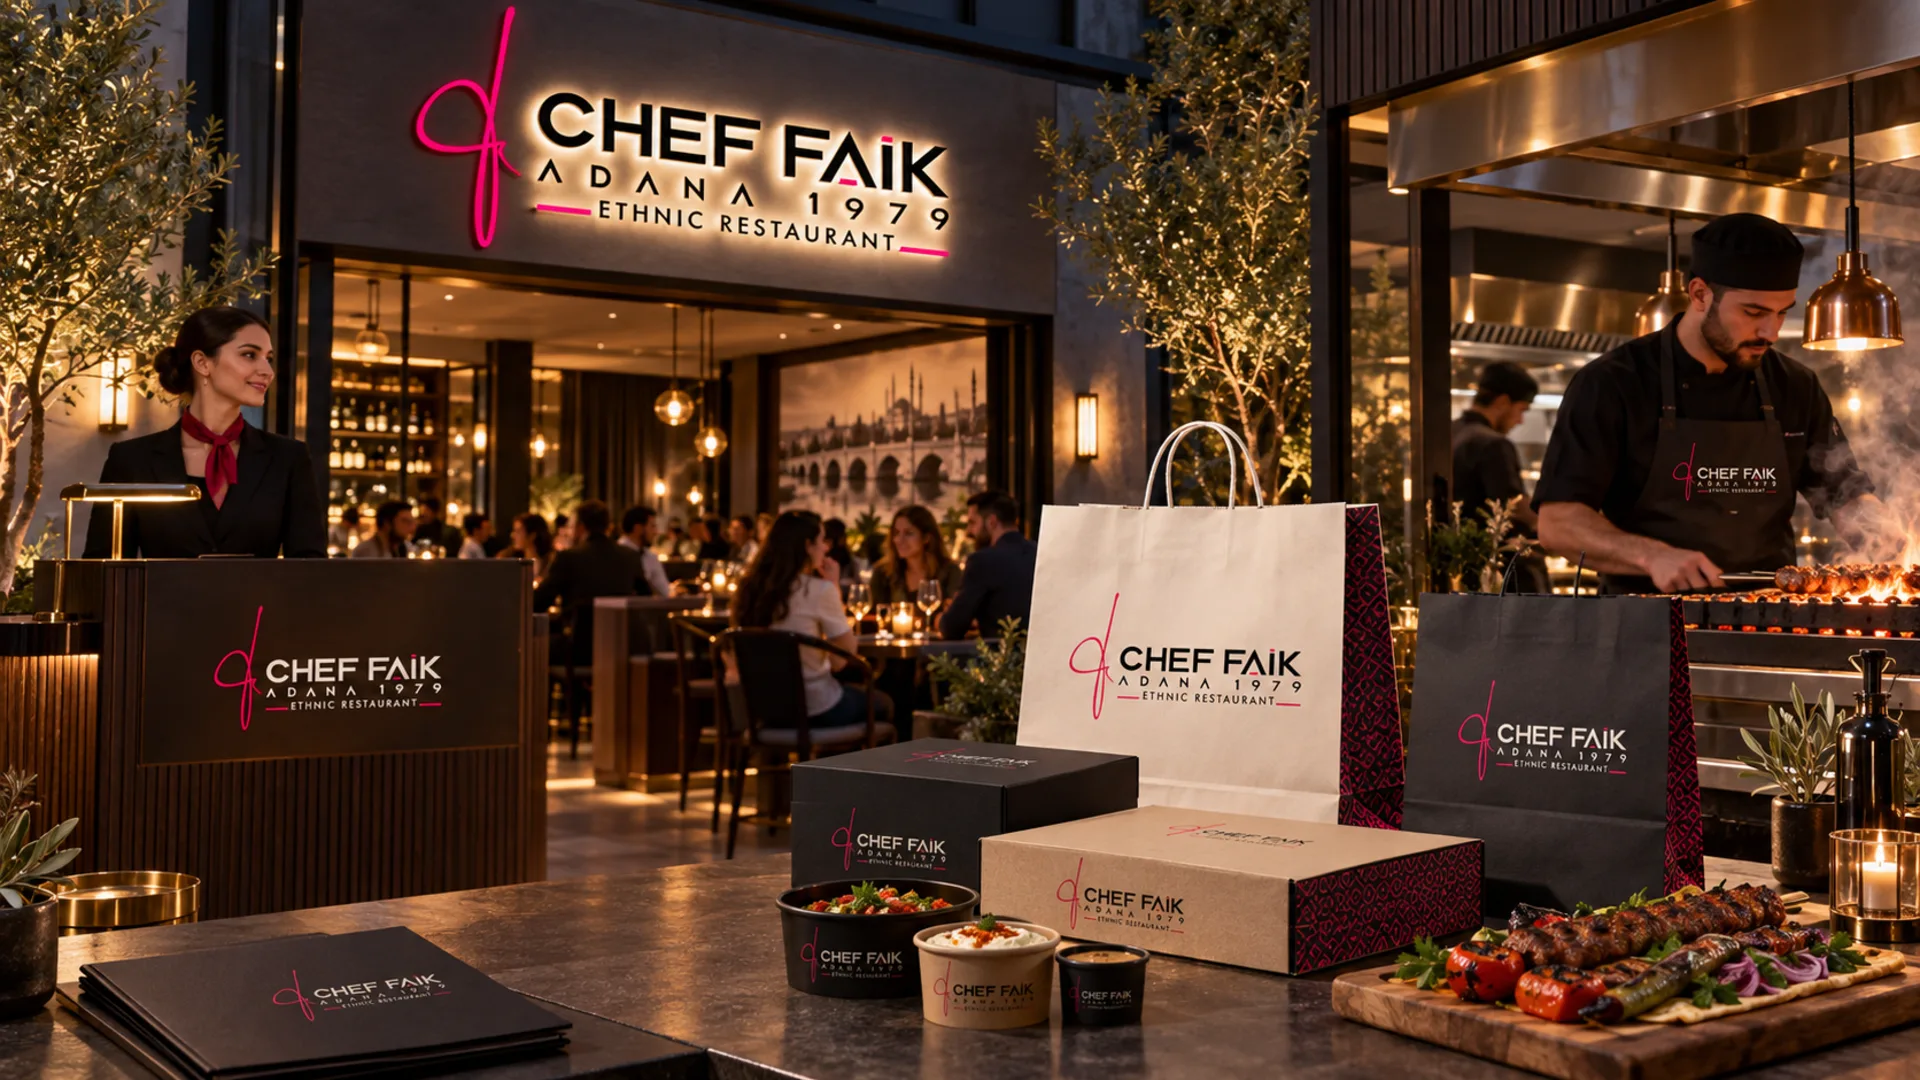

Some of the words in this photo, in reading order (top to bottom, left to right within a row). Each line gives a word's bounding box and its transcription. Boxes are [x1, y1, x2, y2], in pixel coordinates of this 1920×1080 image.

[538, 92, 761, 167] CHEF
[538, 159, 754, 208] ADANA
[808, 192, 950, 231] 1979
[600, 200, 704, 230] ETHNIC
[721, 215, 895, 252] RESTAURANT
[1697, 467, 1739, 479] CHEF
[1119, 646, 1214, 673] CHEF
[266, 658, 359, 683] CHEF
[266, 685, 356, 698] ADANA
[379, 683, 442, 695] 1979
[1118, 675, 1210, 689] ADANA
[1235, 679, 1302, 693] 1979
[290, 700, 335, 711] ETHNIC
[341, 698, 418, 709] RESTAURANT
[1142, 691, 1188, 702] ETHNIC
[1195, 694, 1275, 706] RESTAURANT
[1497, 723, 1565, 746] CHEF
[1497, 747, 1562, 759] ADANA
[1579, 751, 1627, 763] 1979
[1514, 760, 1548, 769] ETHNIC
[1551, 762, 1609, 773] RESTAURANT
[857, 833, 903, 850] CHEF
[1084, 887, 1136, 907] CHEF
[1084, 905, 1135, 918] ADANA
[820, 950, 862, 963] CHEF
[313, 981, 377, 998] CHEF
[953, 984, 996, 997] CHEF
[1081, 990, 1108, 1000] CHEF
